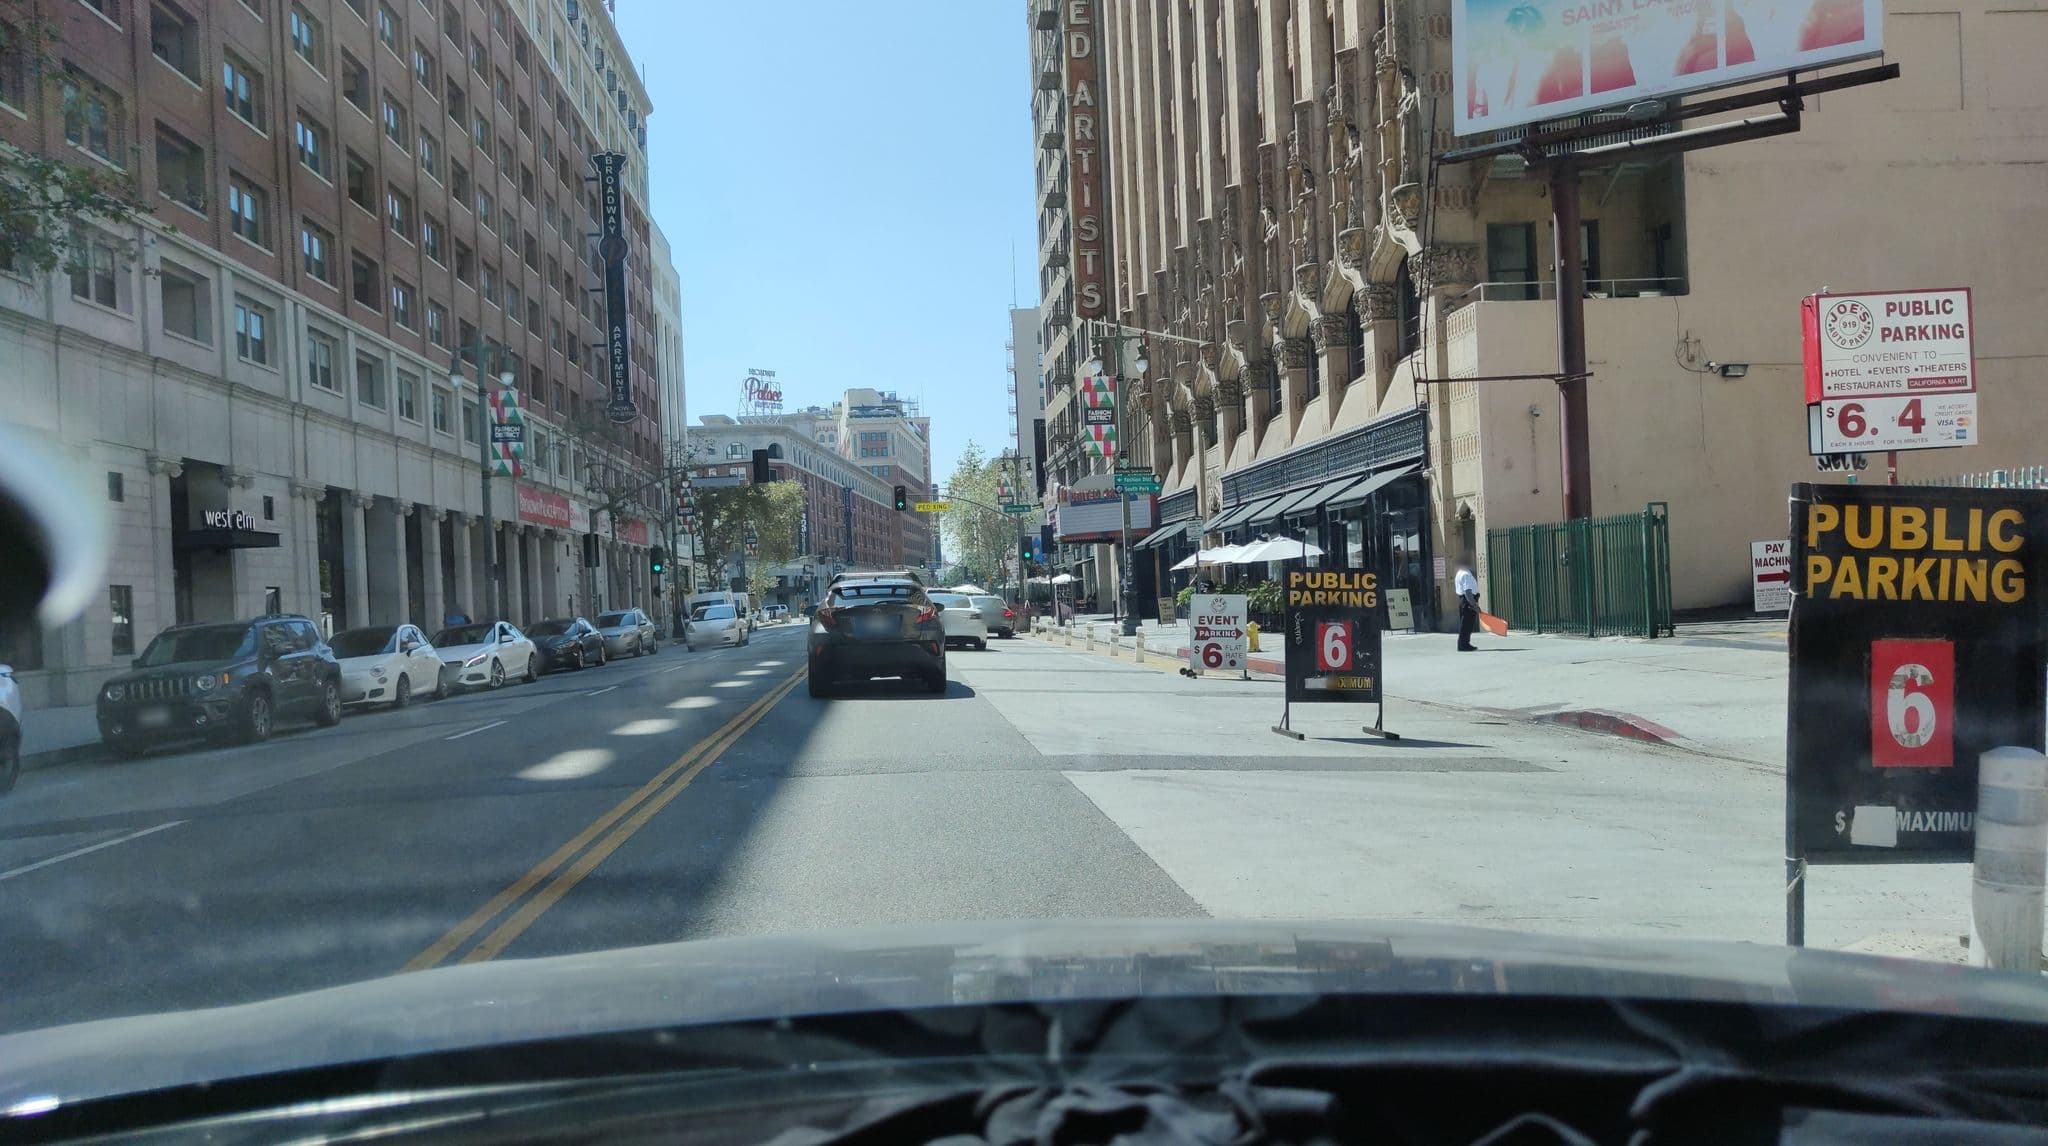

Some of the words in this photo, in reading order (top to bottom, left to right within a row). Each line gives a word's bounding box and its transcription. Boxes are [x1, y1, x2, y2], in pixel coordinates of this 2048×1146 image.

[1562, 0, 1623, 26] SAINT
[605, 156, 617, 235] BROADWAY
[1072, 79, 1101, 309] ARTISTS
[1829, 303, 1870, 323] JOE'S
[1885, 299, 1954, 318] PUBLIC
[1842, 320, 1857, 328] 919
[1881, 324, 1965, 343] PARKING
[1828, 327, 1847, 346] AUTO
[1849, 325, 1872, 347] PARKS
[613, 326, 624, 401] APARTMENTS
[1852, 352, 1919, 364] CONVENIENT
[1923, 350, 1937, 360] TO
[1830, 368, 1862, 378] HOTEL
[1873, 365, 1911, 376] EVENTS
[1919, 363, 1967, 373] THEATERS
[745, 377, 783, 402] Palace
[1834, 380, 1902, 391] RESTAURANTS
[1908, 378, 1947, 387] CALIFORNIA
[1948, 377, 1966, 385] MART
[205, 509, 232, 528] west
[236, 510, 256, 530] elm
[1807, 504, 2025, 553] PUBLIC
[1765, 543, 1785, 554] PAY
[1289, 571, 1377, 590] PUBLIC
[1807, 555, 2026, 603] PARKING
[1289, 590, 1377, 608] PARKING
[1198, 615, 1240, 625] EVENT
[1323, 625, 1347, 668] 6
[1887, 663, 1936, 748] 6
[1835, 811, 1846, 834] $
[1895, 811, 1977, 832] MAXIMU
